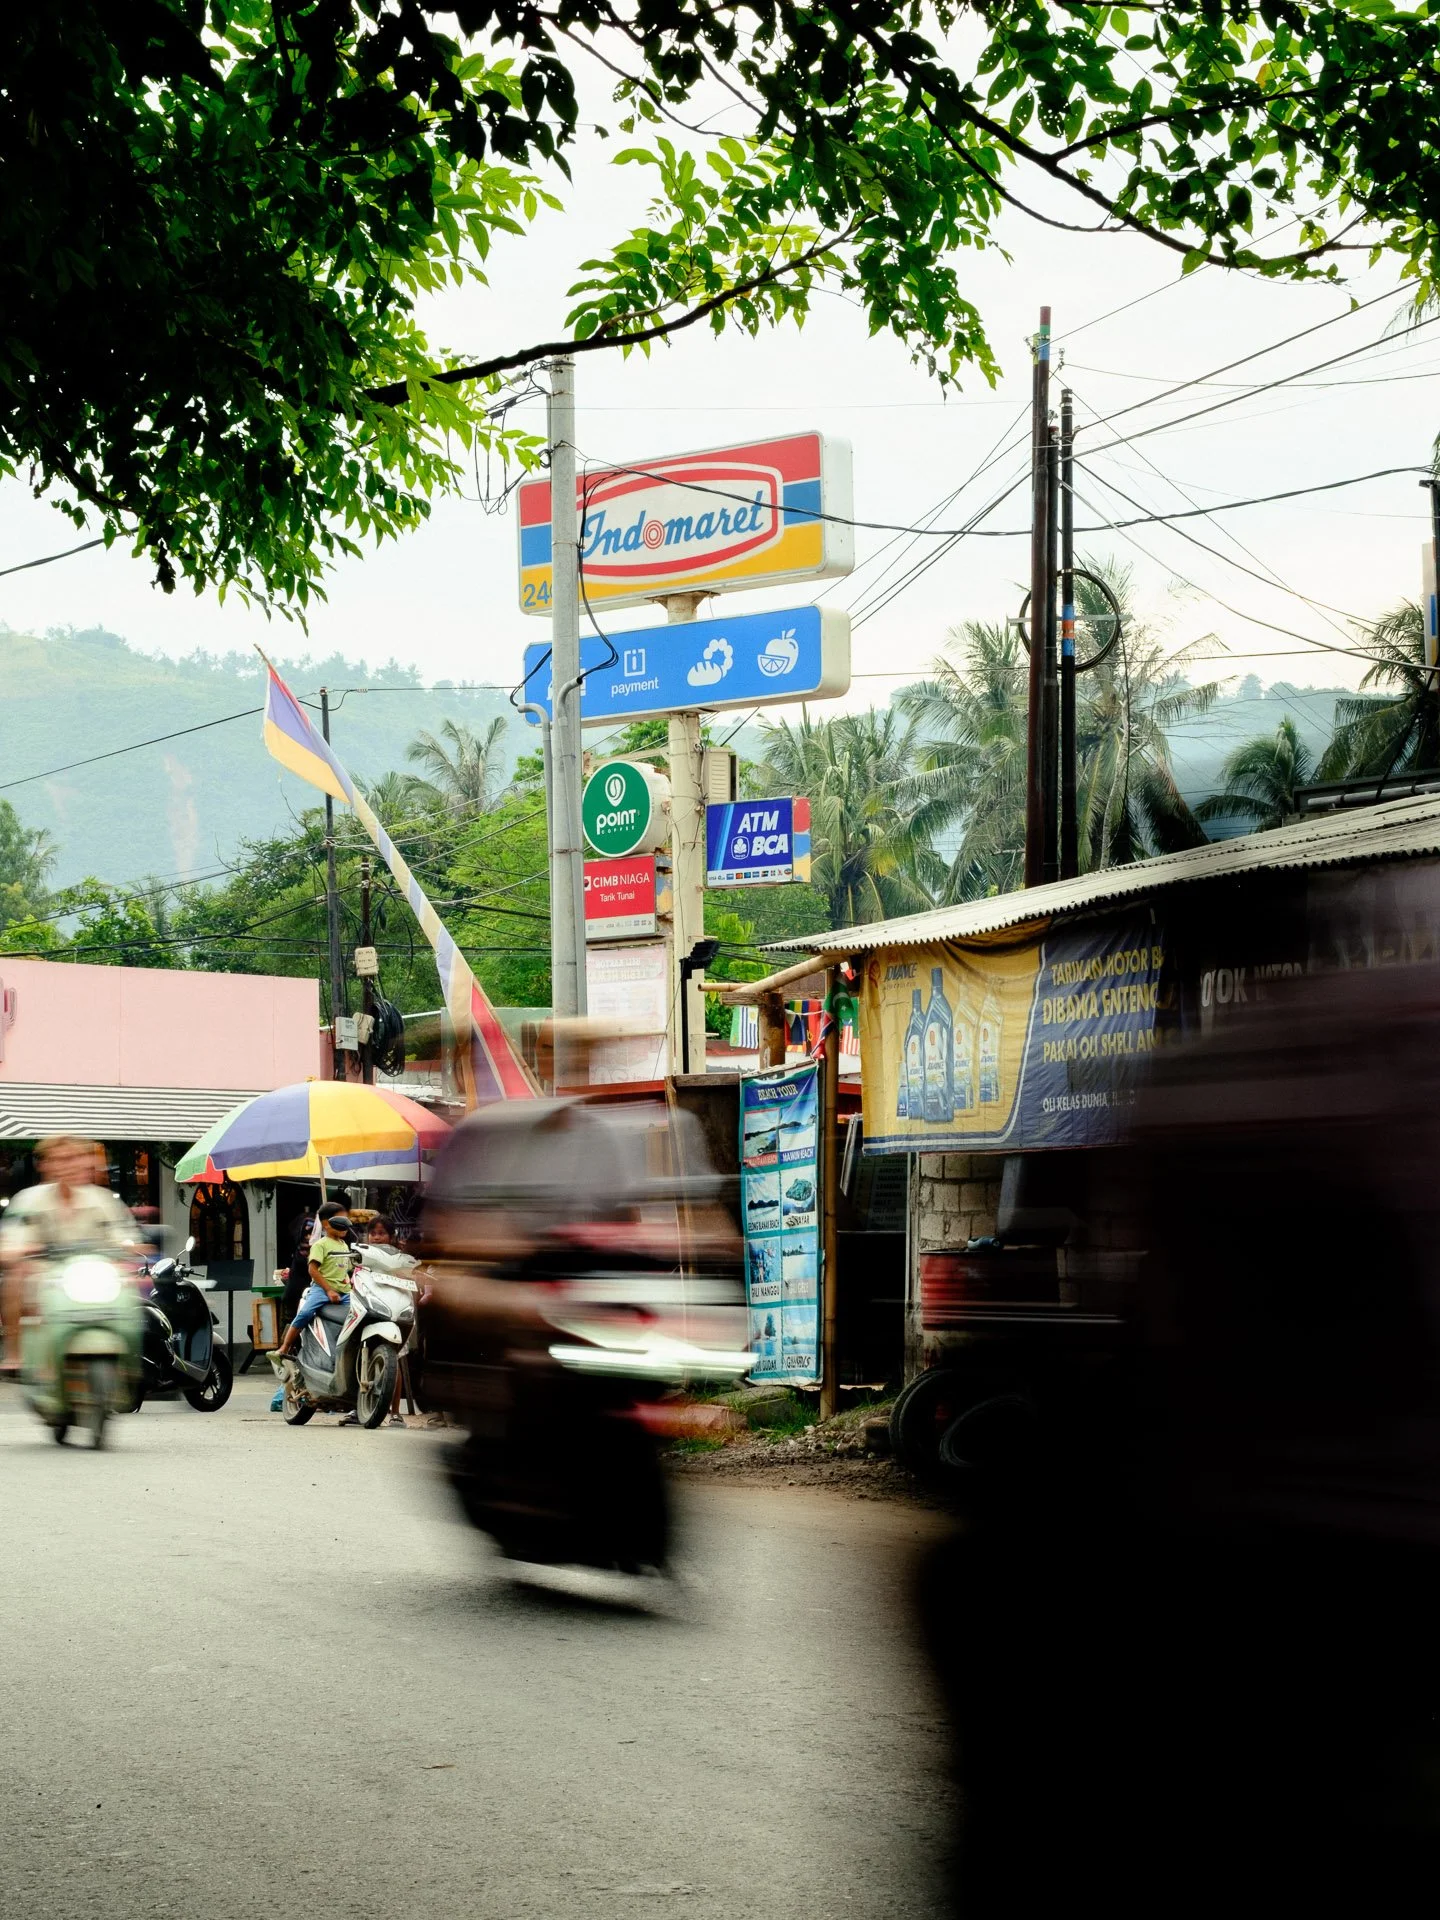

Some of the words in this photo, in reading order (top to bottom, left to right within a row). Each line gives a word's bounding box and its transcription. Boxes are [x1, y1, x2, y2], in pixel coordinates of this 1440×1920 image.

[583, 490, 764, 558] Indomaret
[524, 580, 552, 608] 24
[611, 676, 660, 698] payment
[737, 810, 779, 834] ATM
[751, 833, 788, 856] BCA
[593, 875, 619, 888] CIMB
[619, 872, 650, 885] NIAGA
[600, 892, 616, 902] Tarik
[617, 890, 635, 900] Tunai
[1103, 947, 1149, 977] MOTOR
[1042, 991, 1100, 1025] DIBAWA
[1043, 1037, 1077, 1063] PAKAI
[1079, 1035, 1098, 1060] OLI
[1101, 1030, 1134, 1056] SHELL
[757, 1088, 778, 1101] BEACH
[777, 1084, 799, 1098] TOUR
[1042, 1097, 1056, 1113] OLI
[1056, 1094, 1080, 1111] KELAS
